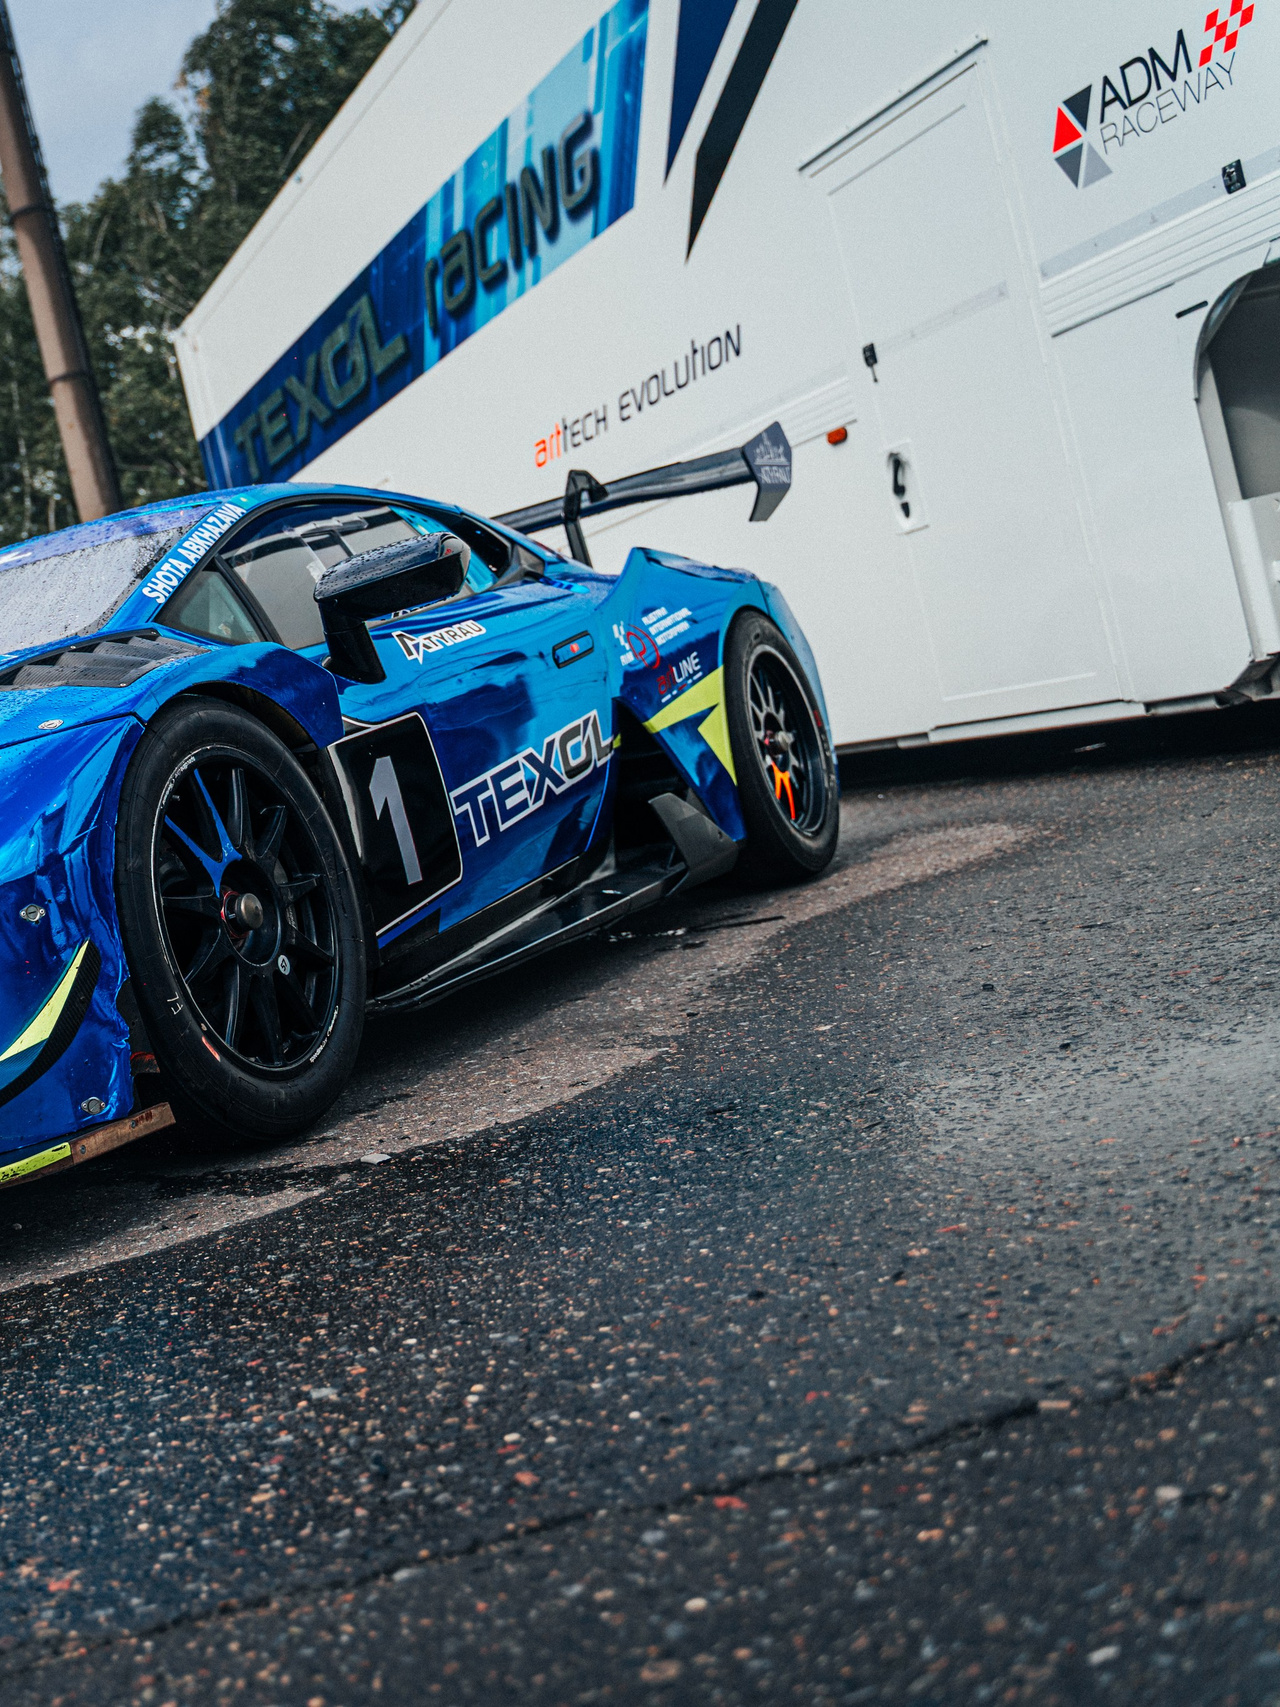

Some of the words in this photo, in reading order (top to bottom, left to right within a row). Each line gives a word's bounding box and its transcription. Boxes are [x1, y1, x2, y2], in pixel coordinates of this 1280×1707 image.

[1099, 51, 1236, 155] RACEWAY
[1100, 28, 1193, 124] ADM
[141, 558, 192, 604] SHOTA
[177, 503, 247, 564] ABKHAZAVA
[391, 619, 487, 665] ATYRAU
[368, 755, 423, 885] 1
